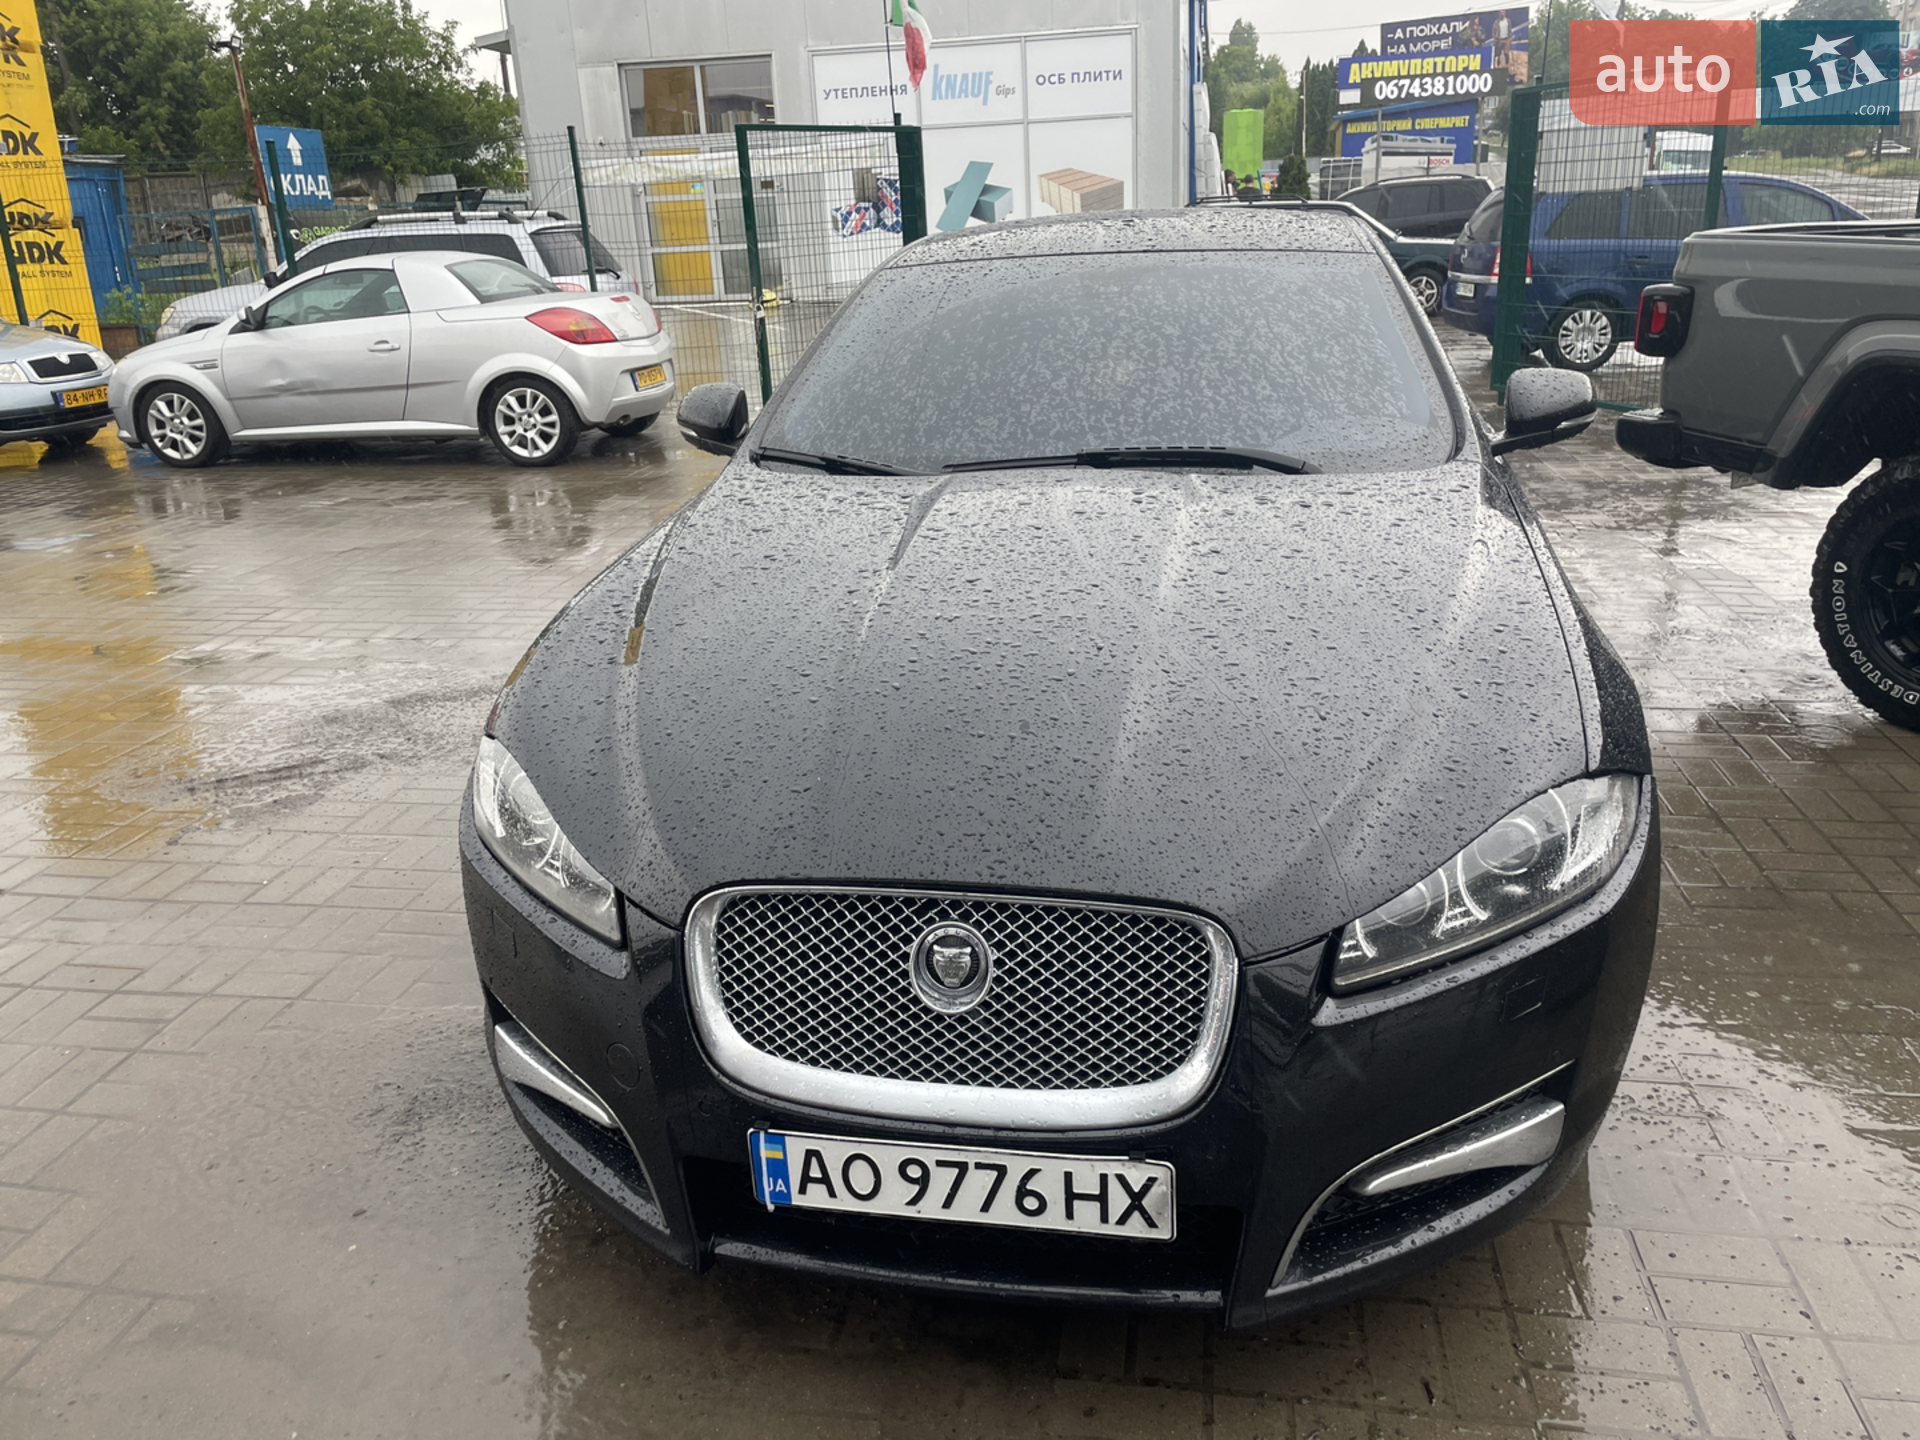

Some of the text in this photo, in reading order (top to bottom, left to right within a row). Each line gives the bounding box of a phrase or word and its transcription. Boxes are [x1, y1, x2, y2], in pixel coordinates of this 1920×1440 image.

[1406, 20, 1470, 39] ПОЇХАЛИ
[1387, 36, 1452, 55] НА МОРЕ!
[0, 69, 31, 81] YSTEM
[1035, 69, 1124, 87] ОСБ ПЛИТИ
[822, 83, 909, 100] УТЕПЛЕННЯ
[930, 63, 1017, 107] KNAUF Gips
[1374, 72, 1493, 100] 0674381000
[1346, 117, 1412, 134] АКУМУЛТОРНИЙ
[0, 130, 44, 156] DK
[1832, 579, 1920, 705] DESTINATION
[897, 1156, 1049, 1218] 9776
